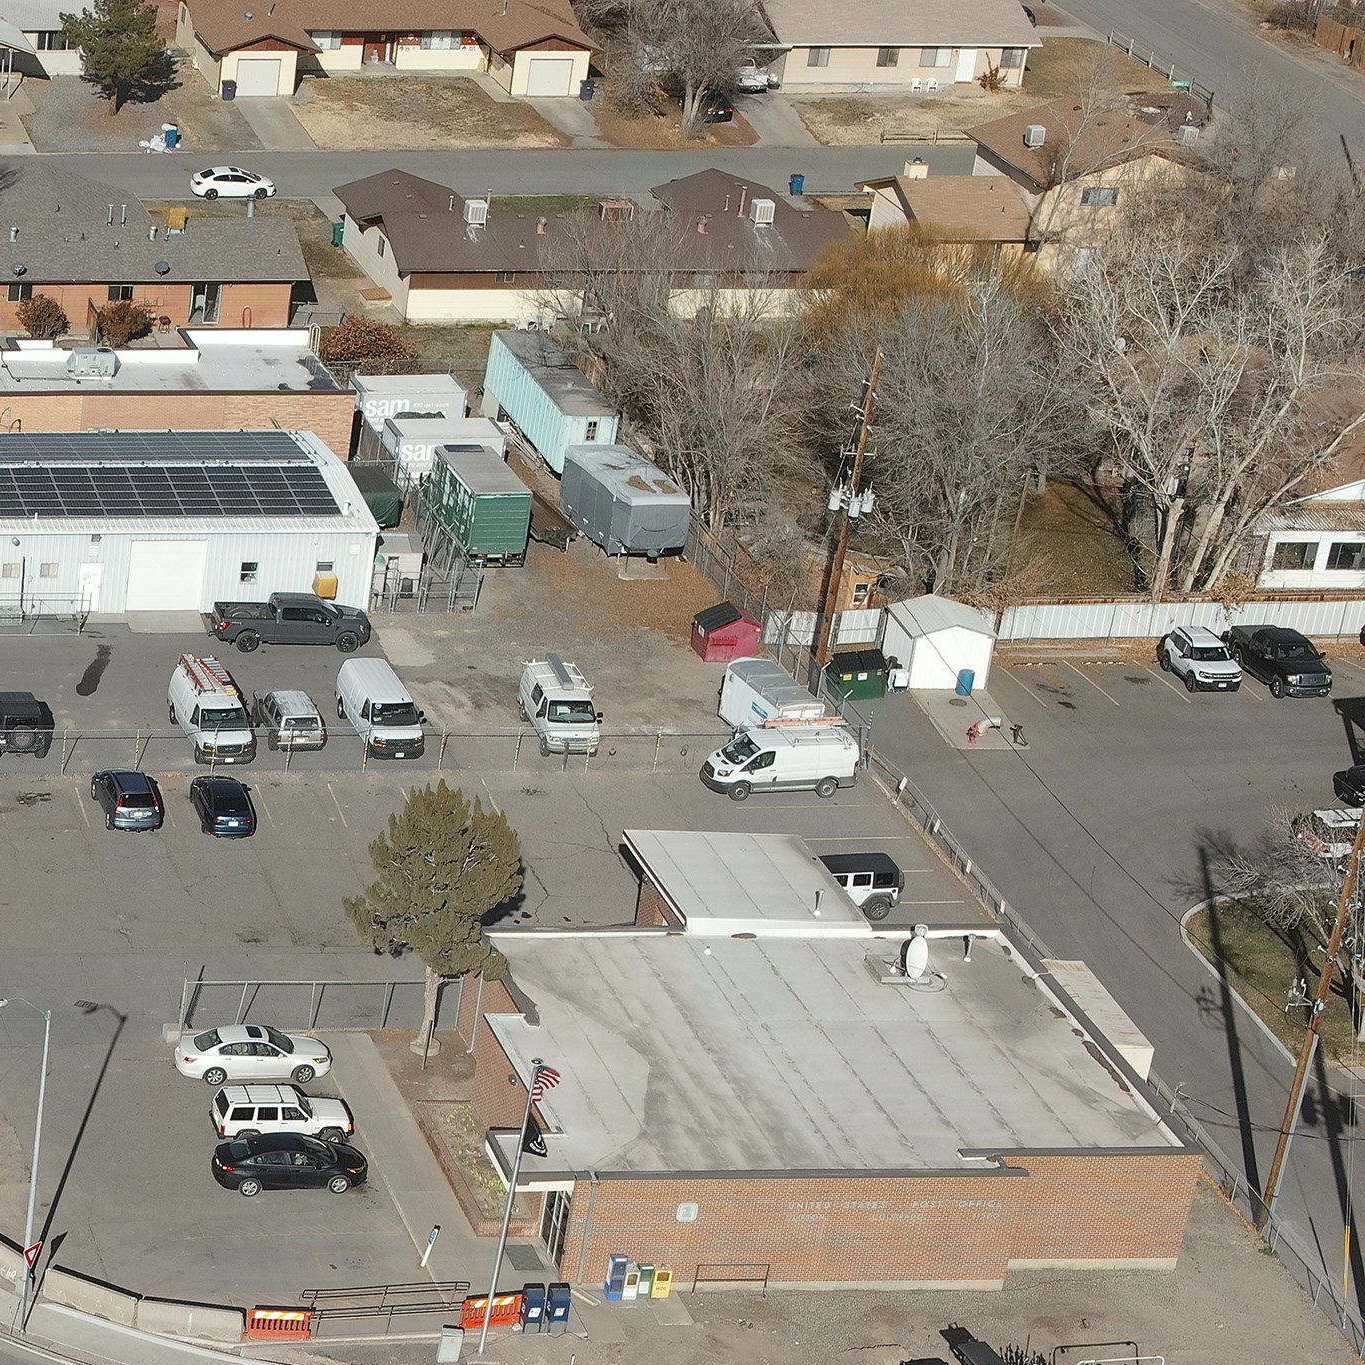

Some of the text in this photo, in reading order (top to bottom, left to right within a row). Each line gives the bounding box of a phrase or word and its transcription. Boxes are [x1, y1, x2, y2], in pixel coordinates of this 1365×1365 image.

[365, 399, 410, 417] sam
[843, 1201, 887, 1209] STATES
[958, 1200, 1004, 1208] OFFICE
